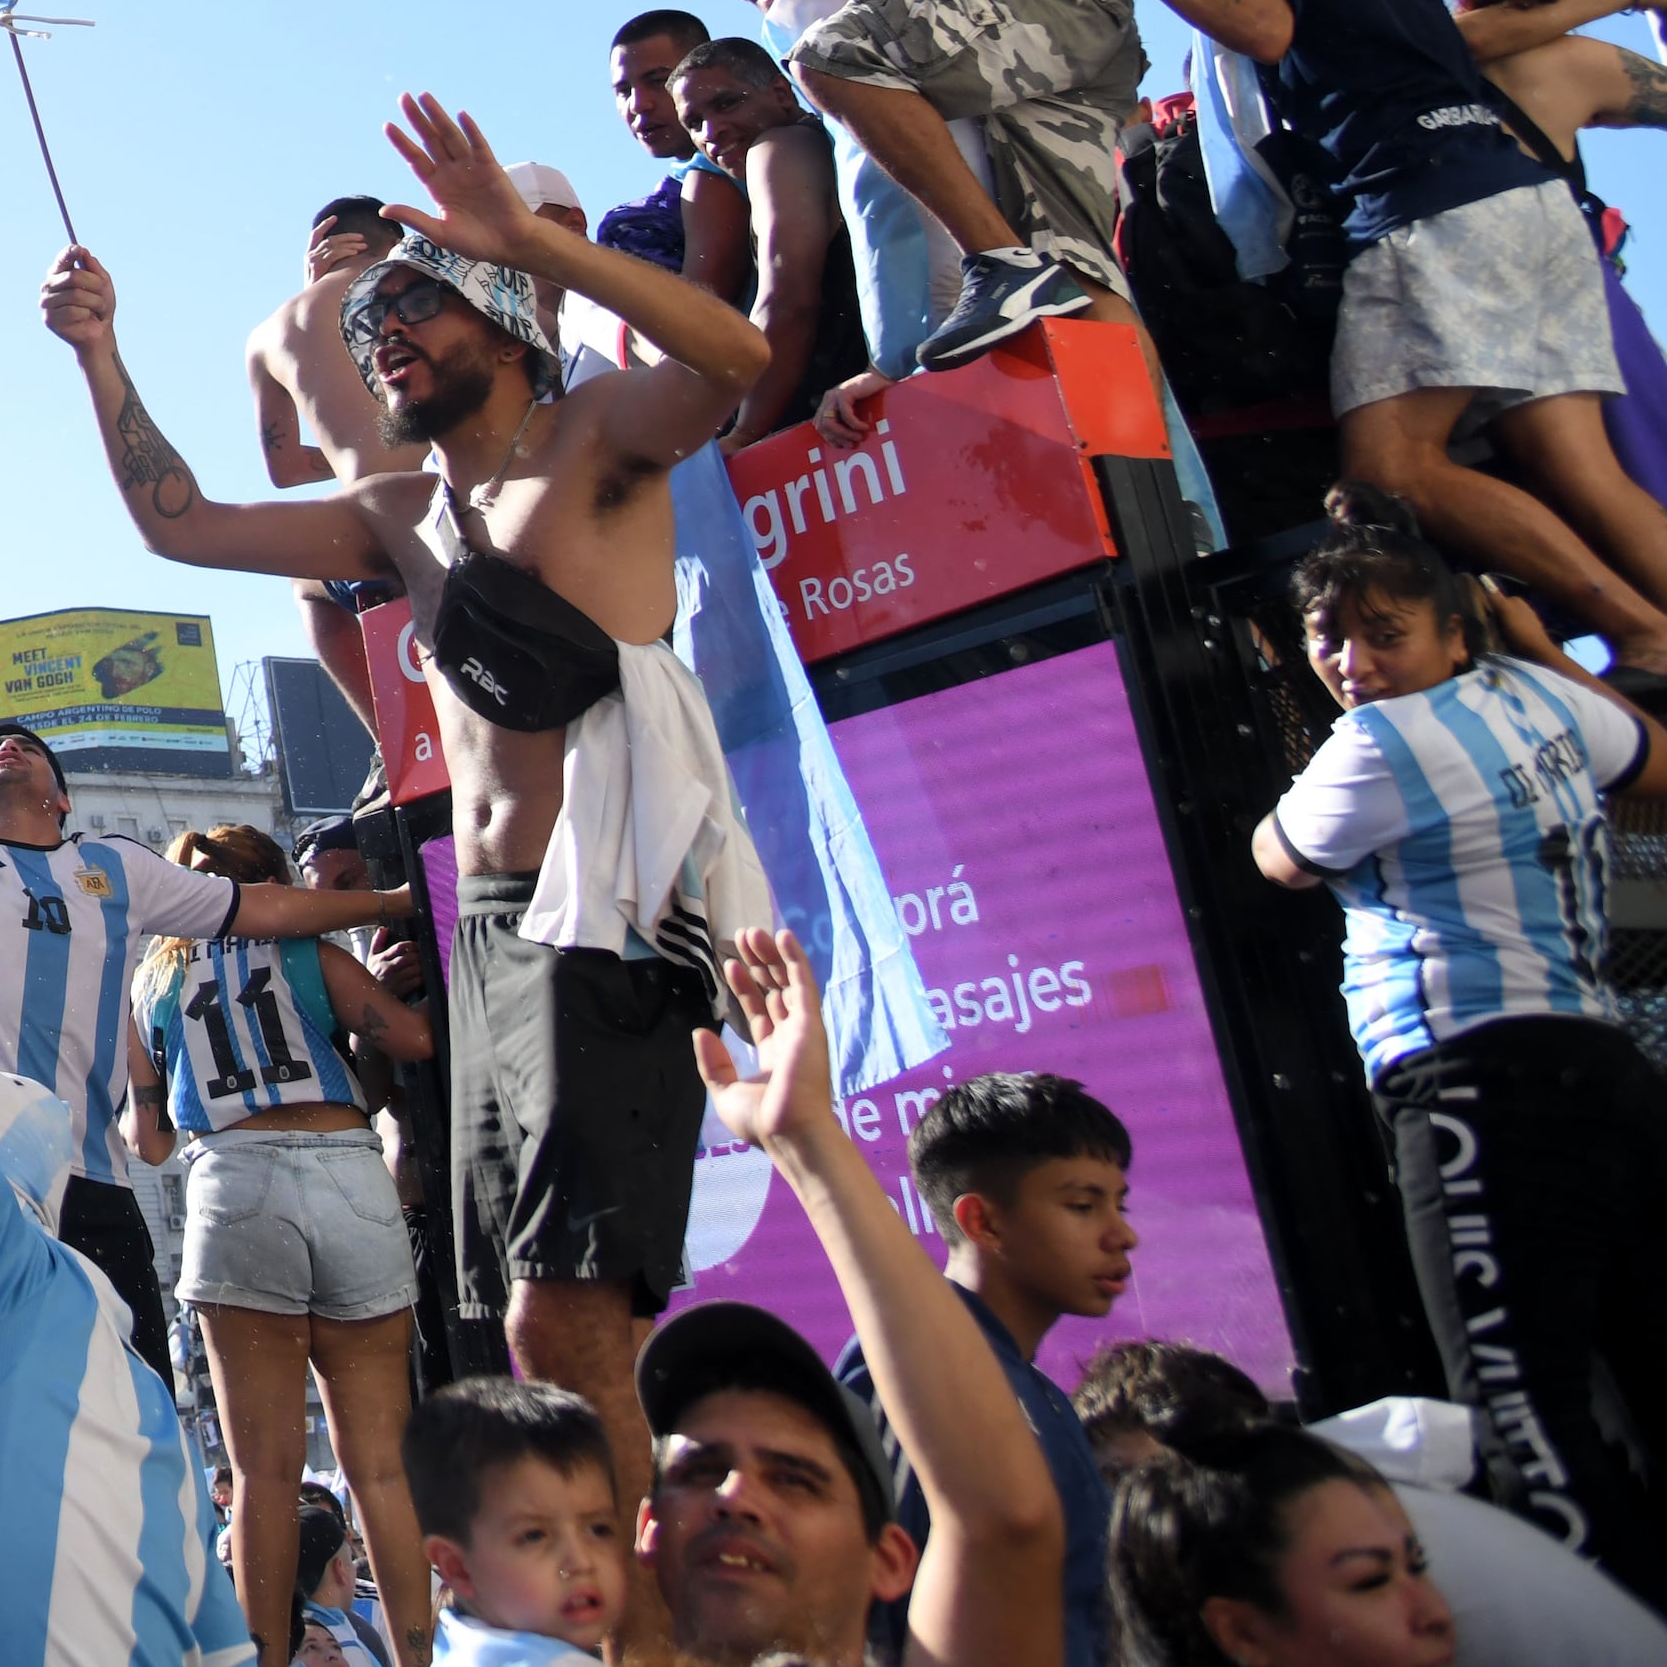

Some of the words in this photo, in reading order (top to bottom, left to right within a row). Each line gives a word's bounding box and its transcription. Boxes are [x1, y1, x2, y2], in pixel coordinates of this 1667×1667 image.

[742, 418, 907, 571] grini
[799, 552, 915, 621] Rosas
[12, 647, 47, 665] MEET
[24, 654, 83, 676] VINCENT
[5, 677, 33, 694] VAN
[37, 671, 74, 689] GOGH
[17, 710, 55, 724] CAMPO
[57, 704, 118, 717] ARGENTINO
[121, 705, 135, 714] DE
[136, 706, 162, 715] POLO
[114, 713, 159, 723] FEBRERO
[22, 887, 72, 935] 10
[926, 953, 1092, 1033] asajes
[184, 966, 313, 1100] 11
